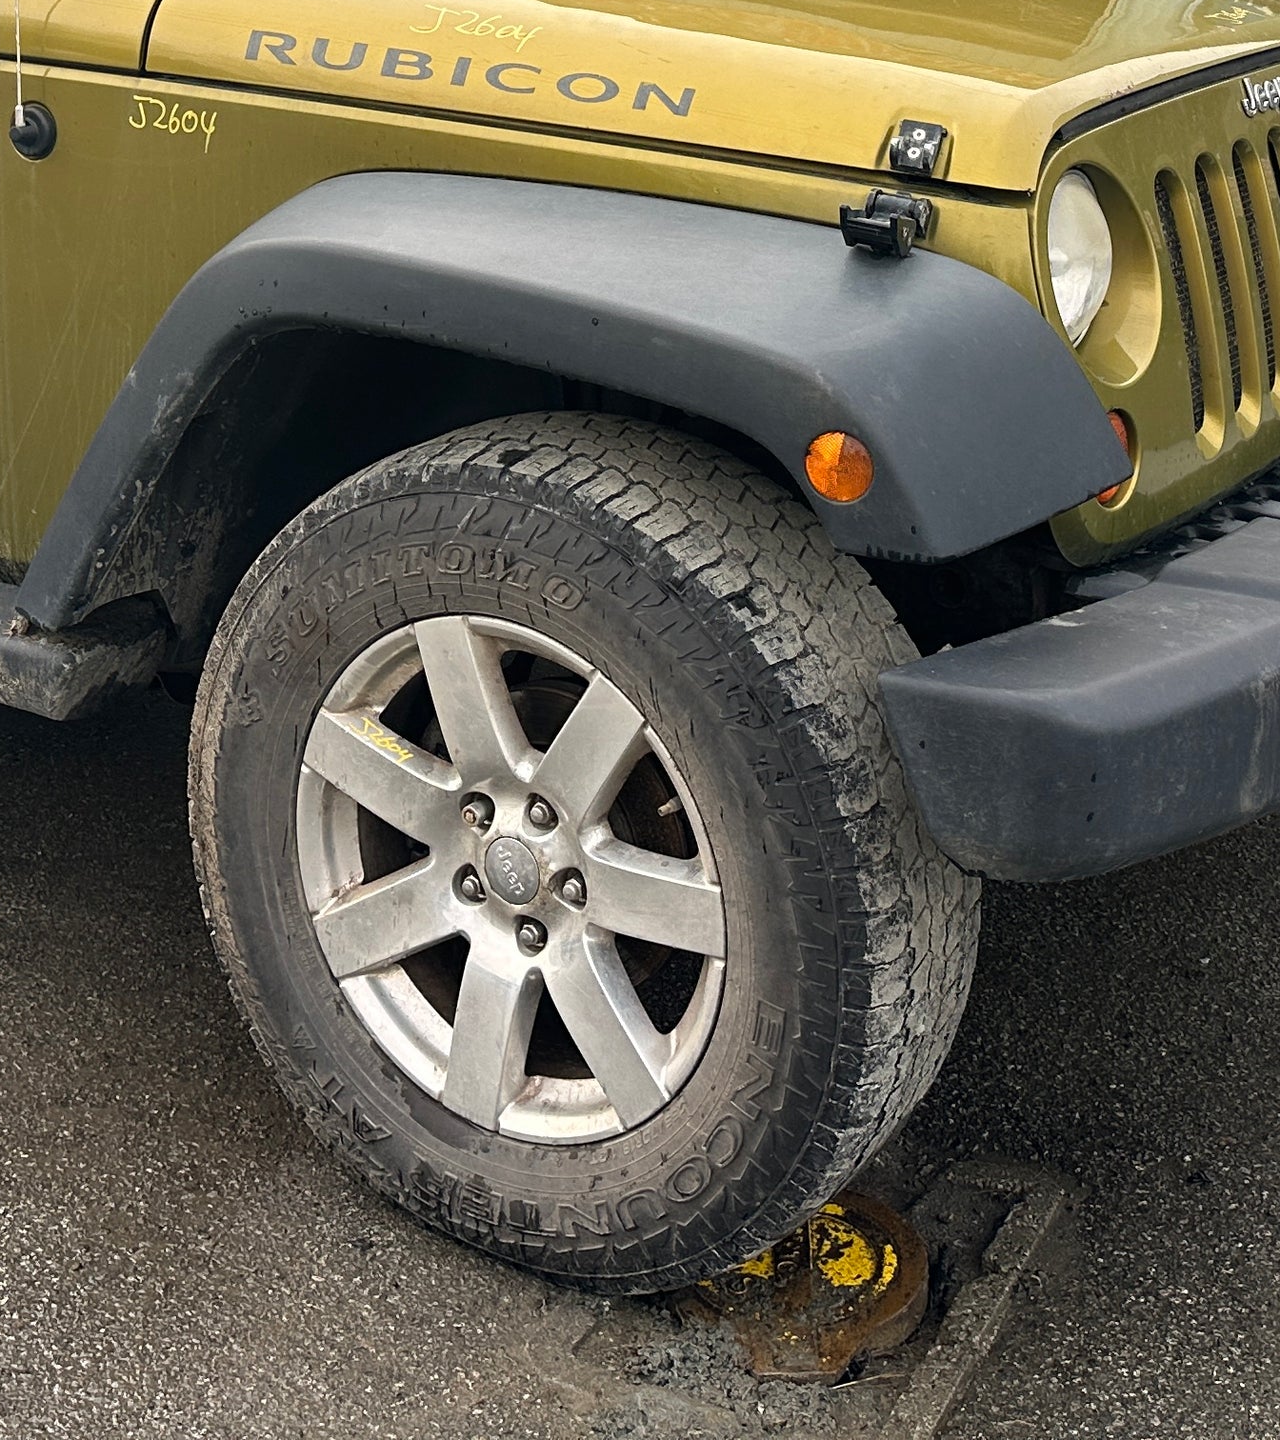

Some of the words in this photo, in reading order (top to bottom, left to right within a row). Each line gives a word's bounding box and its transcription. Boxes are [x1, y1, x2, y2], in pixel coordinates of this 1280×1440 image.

[408, 4, 545, 53] J2604
[244, 30, 698, 118] RUBICON
[128, 94, 218, 153] J2604
[264, 541, 587, 678] SUMITOMO
[495, 844, 526, 897] Jeep
